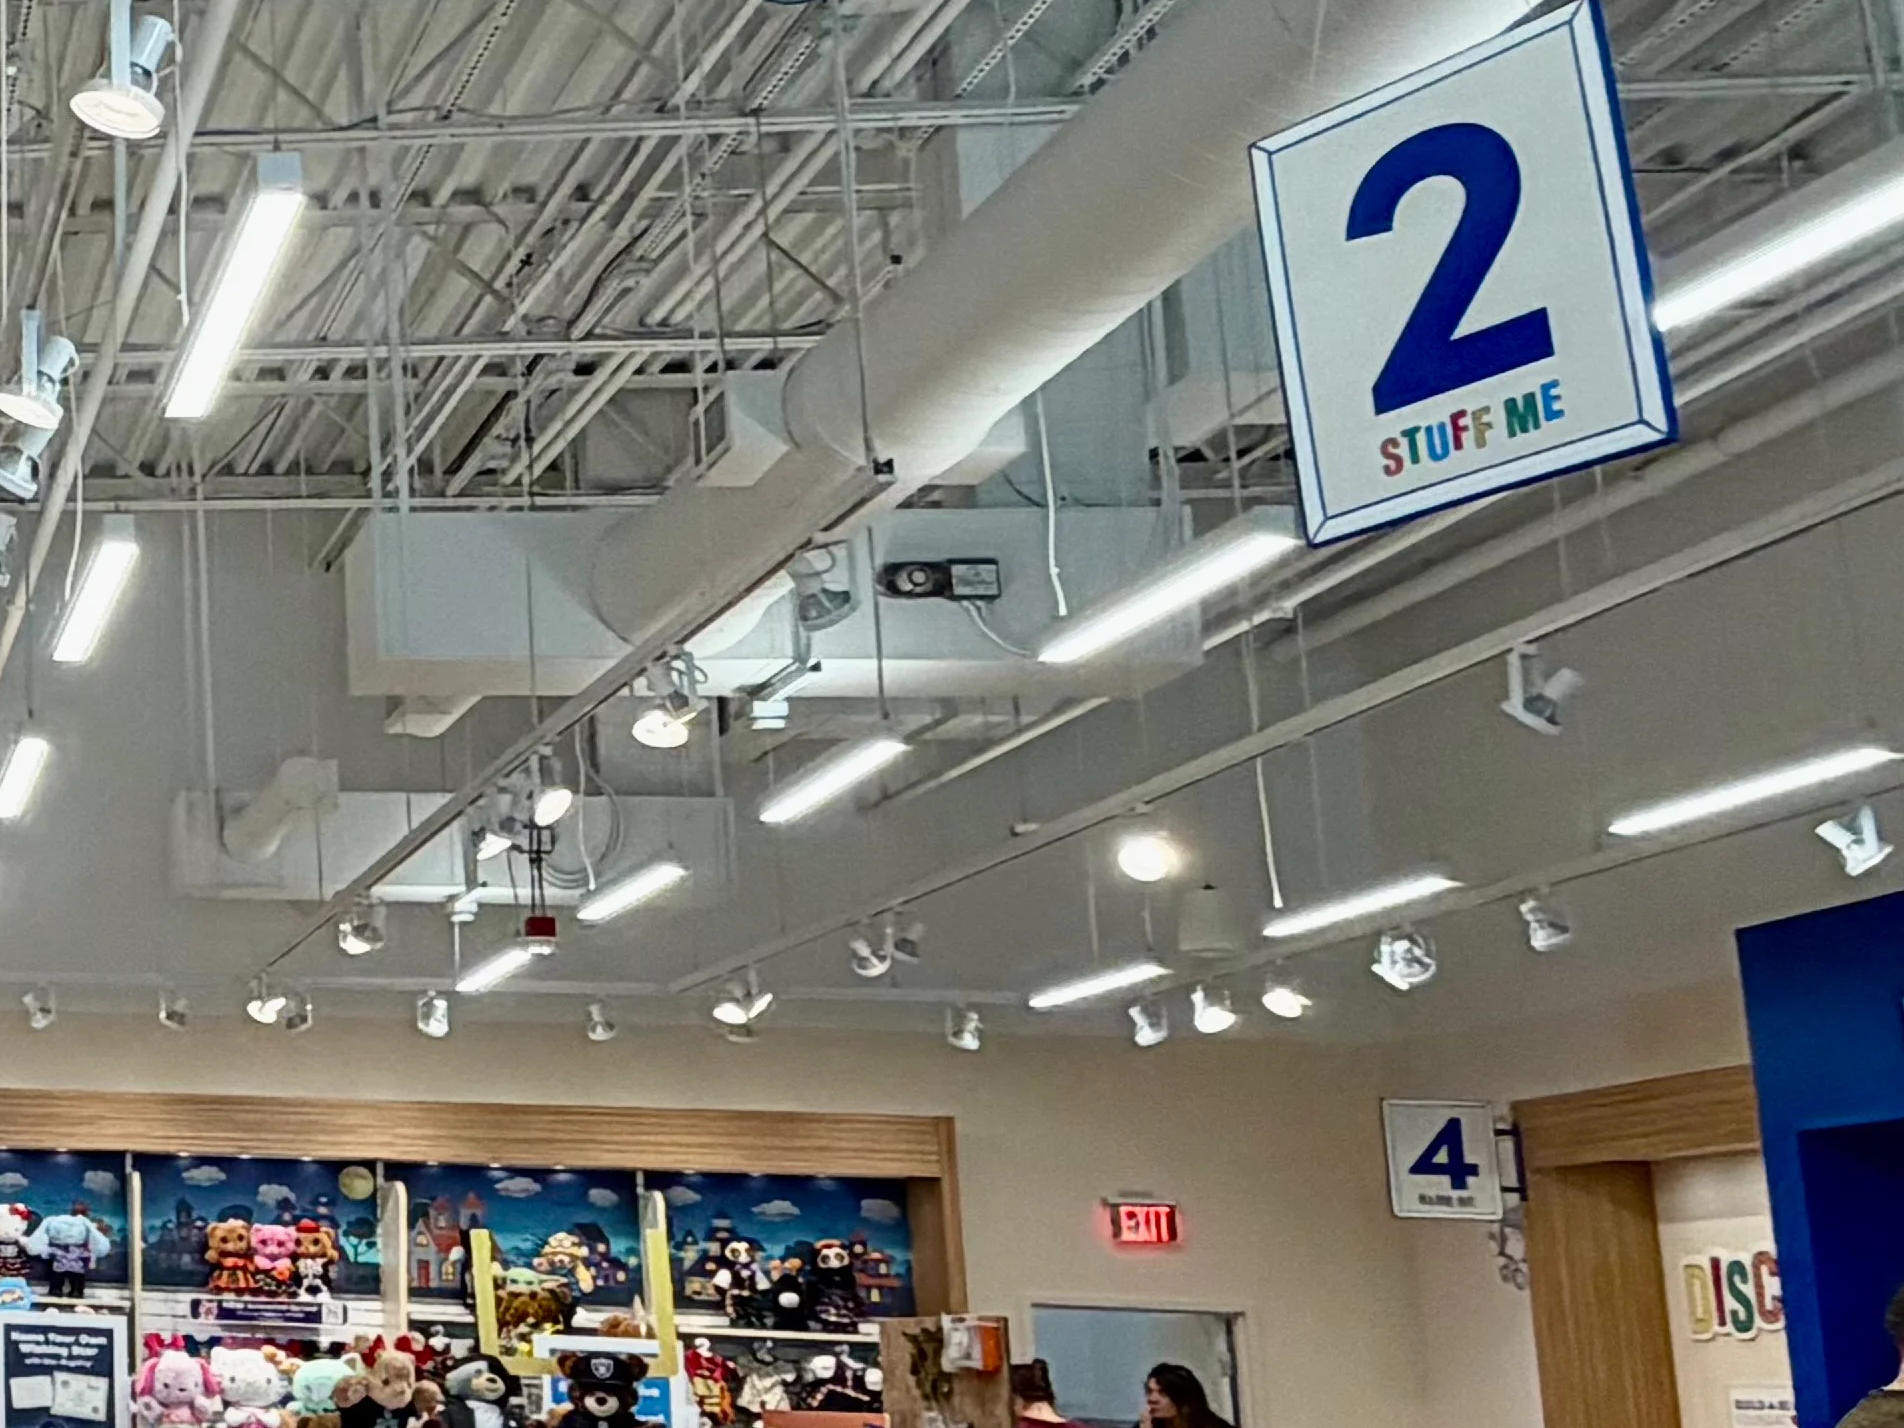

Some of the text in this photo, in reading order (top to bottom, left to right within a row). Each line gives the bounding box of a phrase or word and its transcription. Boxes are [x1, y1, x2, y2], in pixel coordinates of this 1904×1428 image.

[1345, 122, 1556, 415] 2
[1380, 379, 1565, 476] STUFF ME
[1408, 1116, 1480, 1190] 4
[1119, 1205, 1171, 1243] EXIT
[1683, 1250, 1785, 1335] DISC
